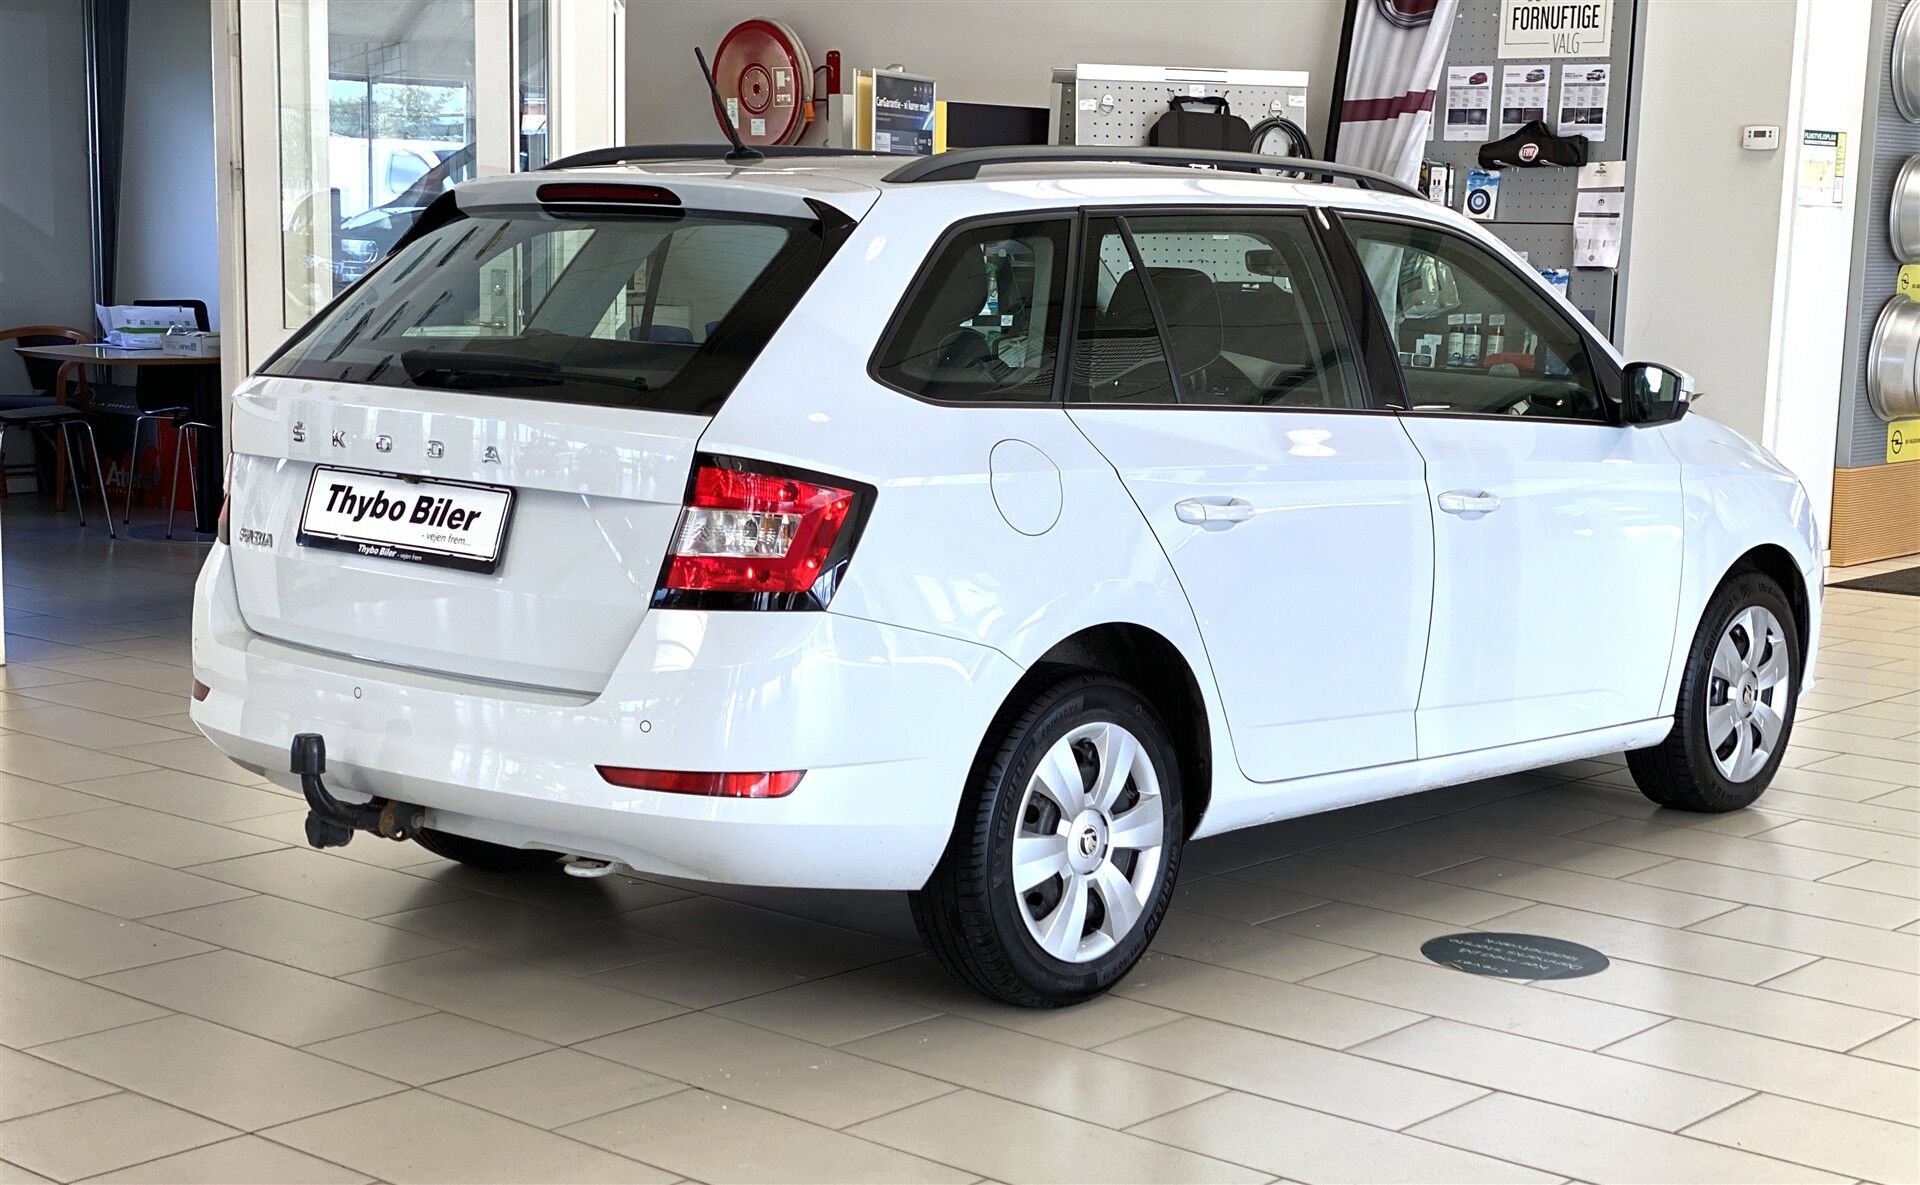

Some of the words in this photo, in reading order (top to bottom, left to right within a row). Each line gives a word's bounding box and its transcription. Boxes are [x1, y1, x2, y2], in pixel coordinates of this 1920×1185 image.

[1512, 4, 1600, 30] FORNUFTIGE
[1552, 32, 1580, 54] VALG
[292, 420, 502, 464] ŠKODA
[326, 484, 406, 522] Thybo
[409, 495, 481, 531] Biler
[426, 532, 446, 543] vejen
[358, 544, 379, 556] Thybo
[379, 546, 397, 557] Biler
